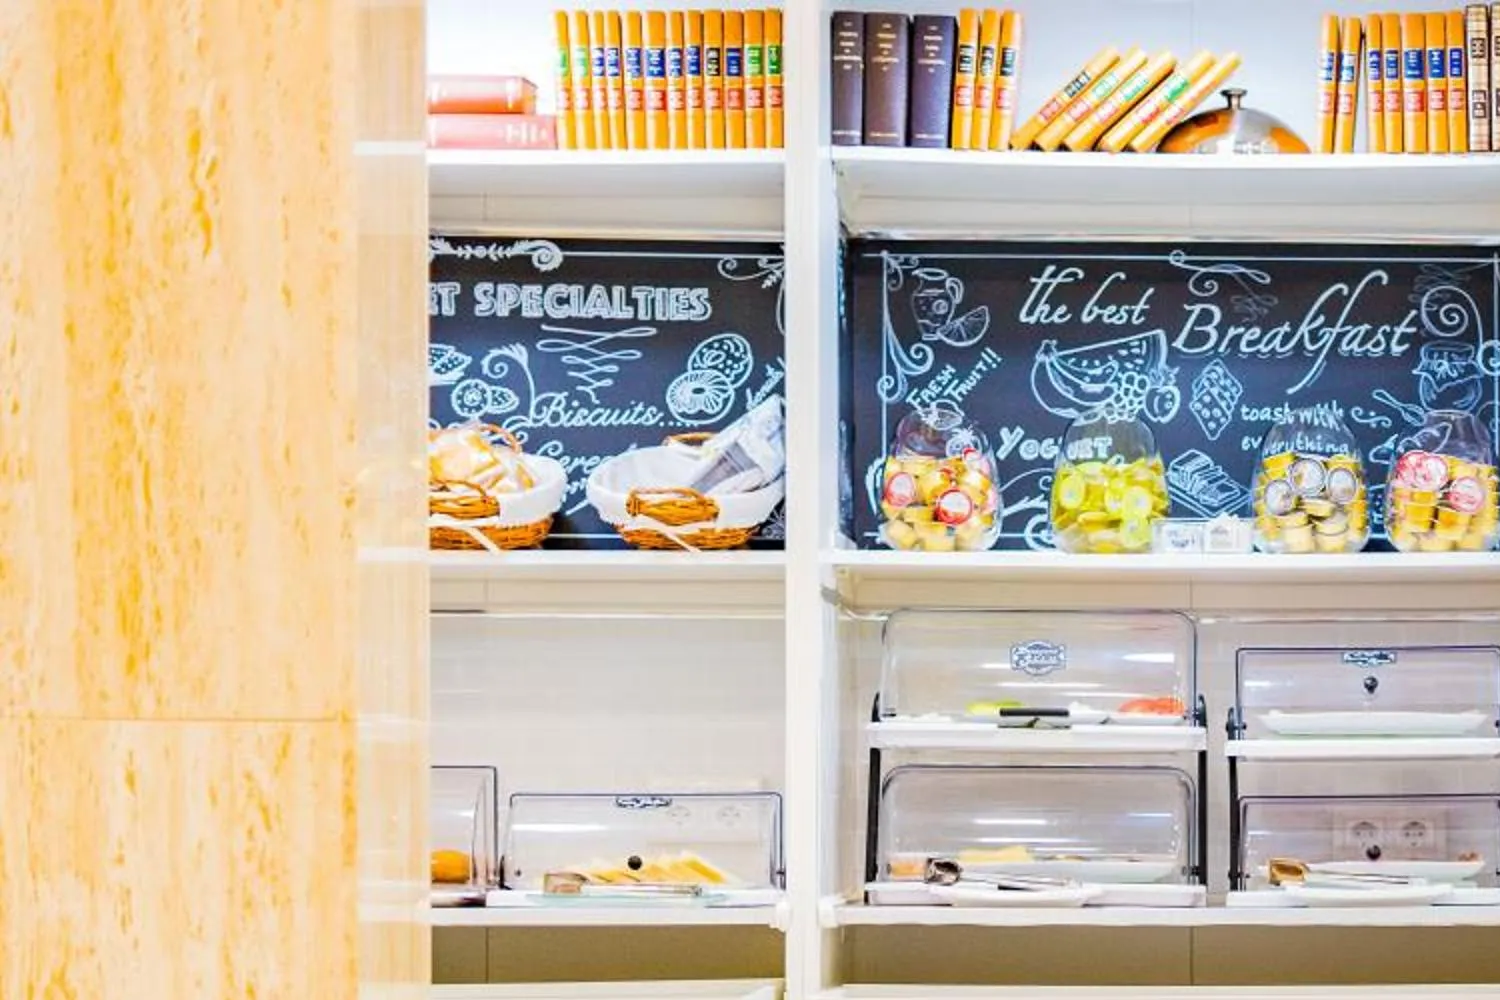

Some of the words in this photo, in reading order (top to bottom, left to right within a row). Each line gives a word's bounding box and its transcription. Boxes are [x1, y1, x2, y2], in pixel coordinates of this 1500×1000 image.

[473, 281, 713, 322] SPECIALTIES
[1020, 265, 1084, 324] the
[1081, 271, 1154, 324] best
[1171, 270, 1418, 394] Breakfast
